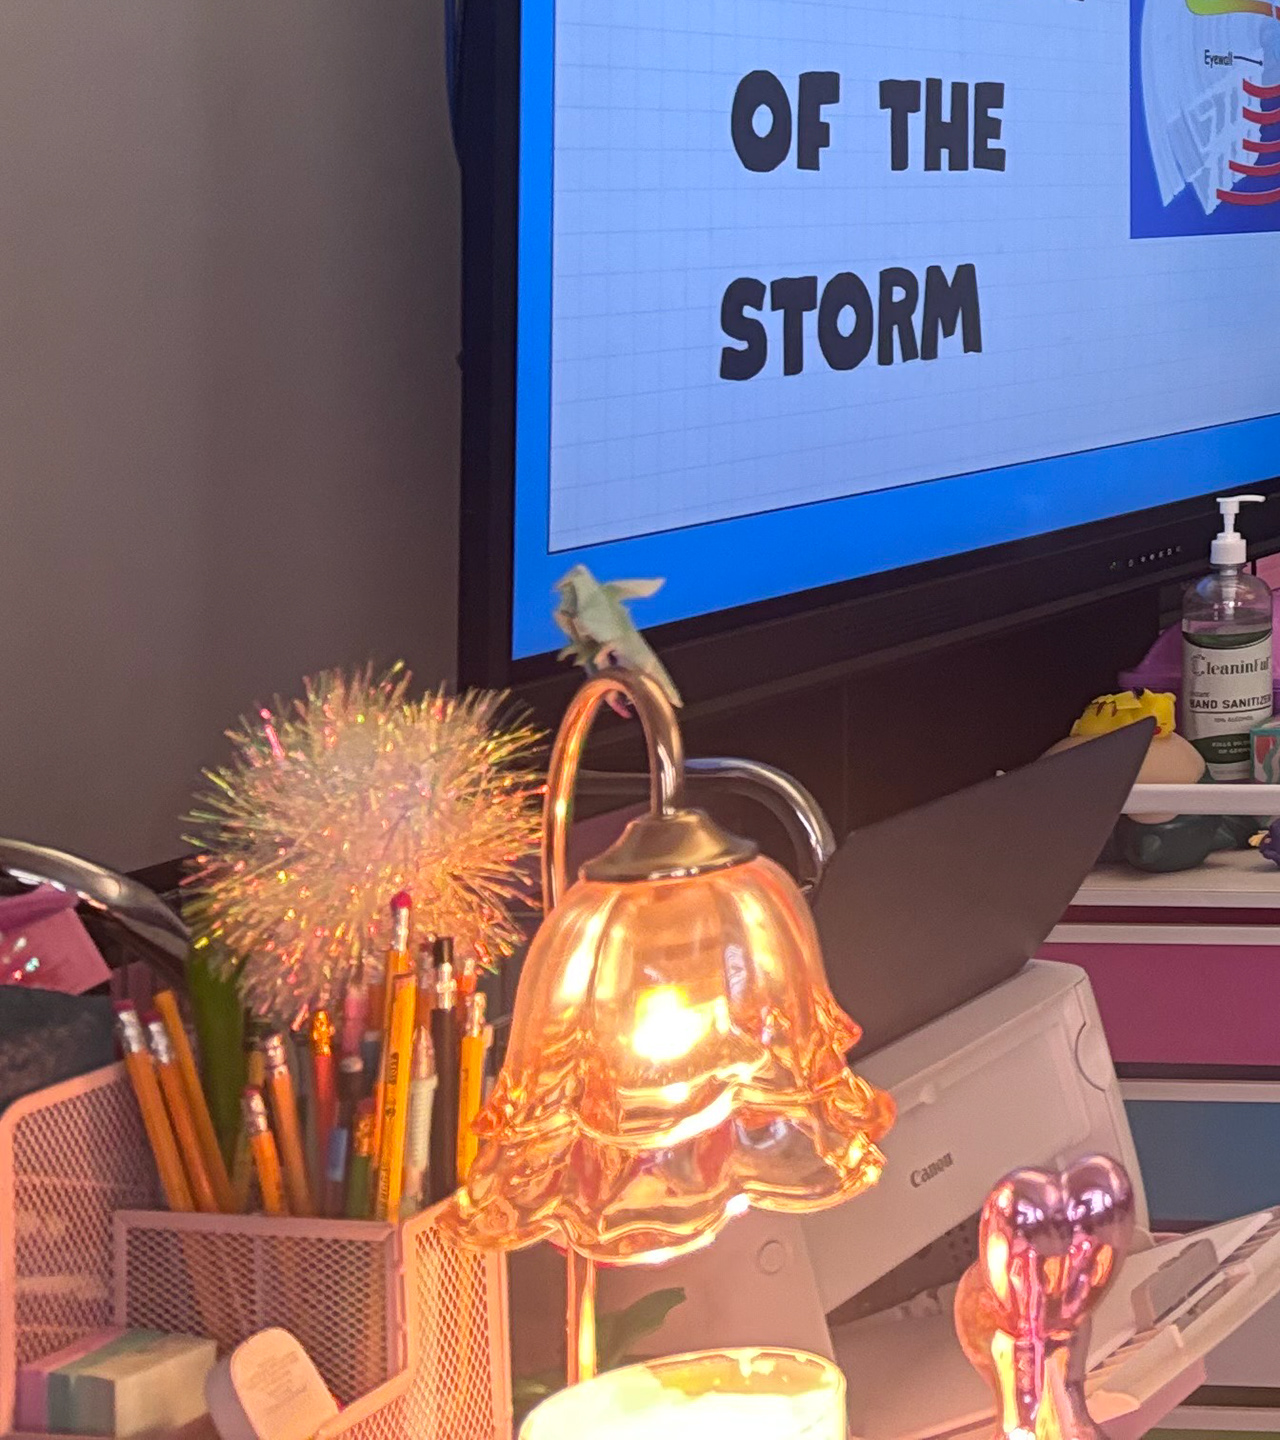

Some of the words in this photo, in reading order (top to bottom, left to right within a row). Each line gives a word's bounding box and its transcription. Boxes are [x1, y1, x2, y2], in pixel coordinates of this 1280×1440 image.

[1204, 49, 1234, 68] Eyewall
[731, 70, 841, 172] OF
[880, 77, 1006, 172] THE
[719, 262, 982, 381] STORM
[1190, 698, 1218, 710] HAND
[910, 1152, 953, 1188] Canon
